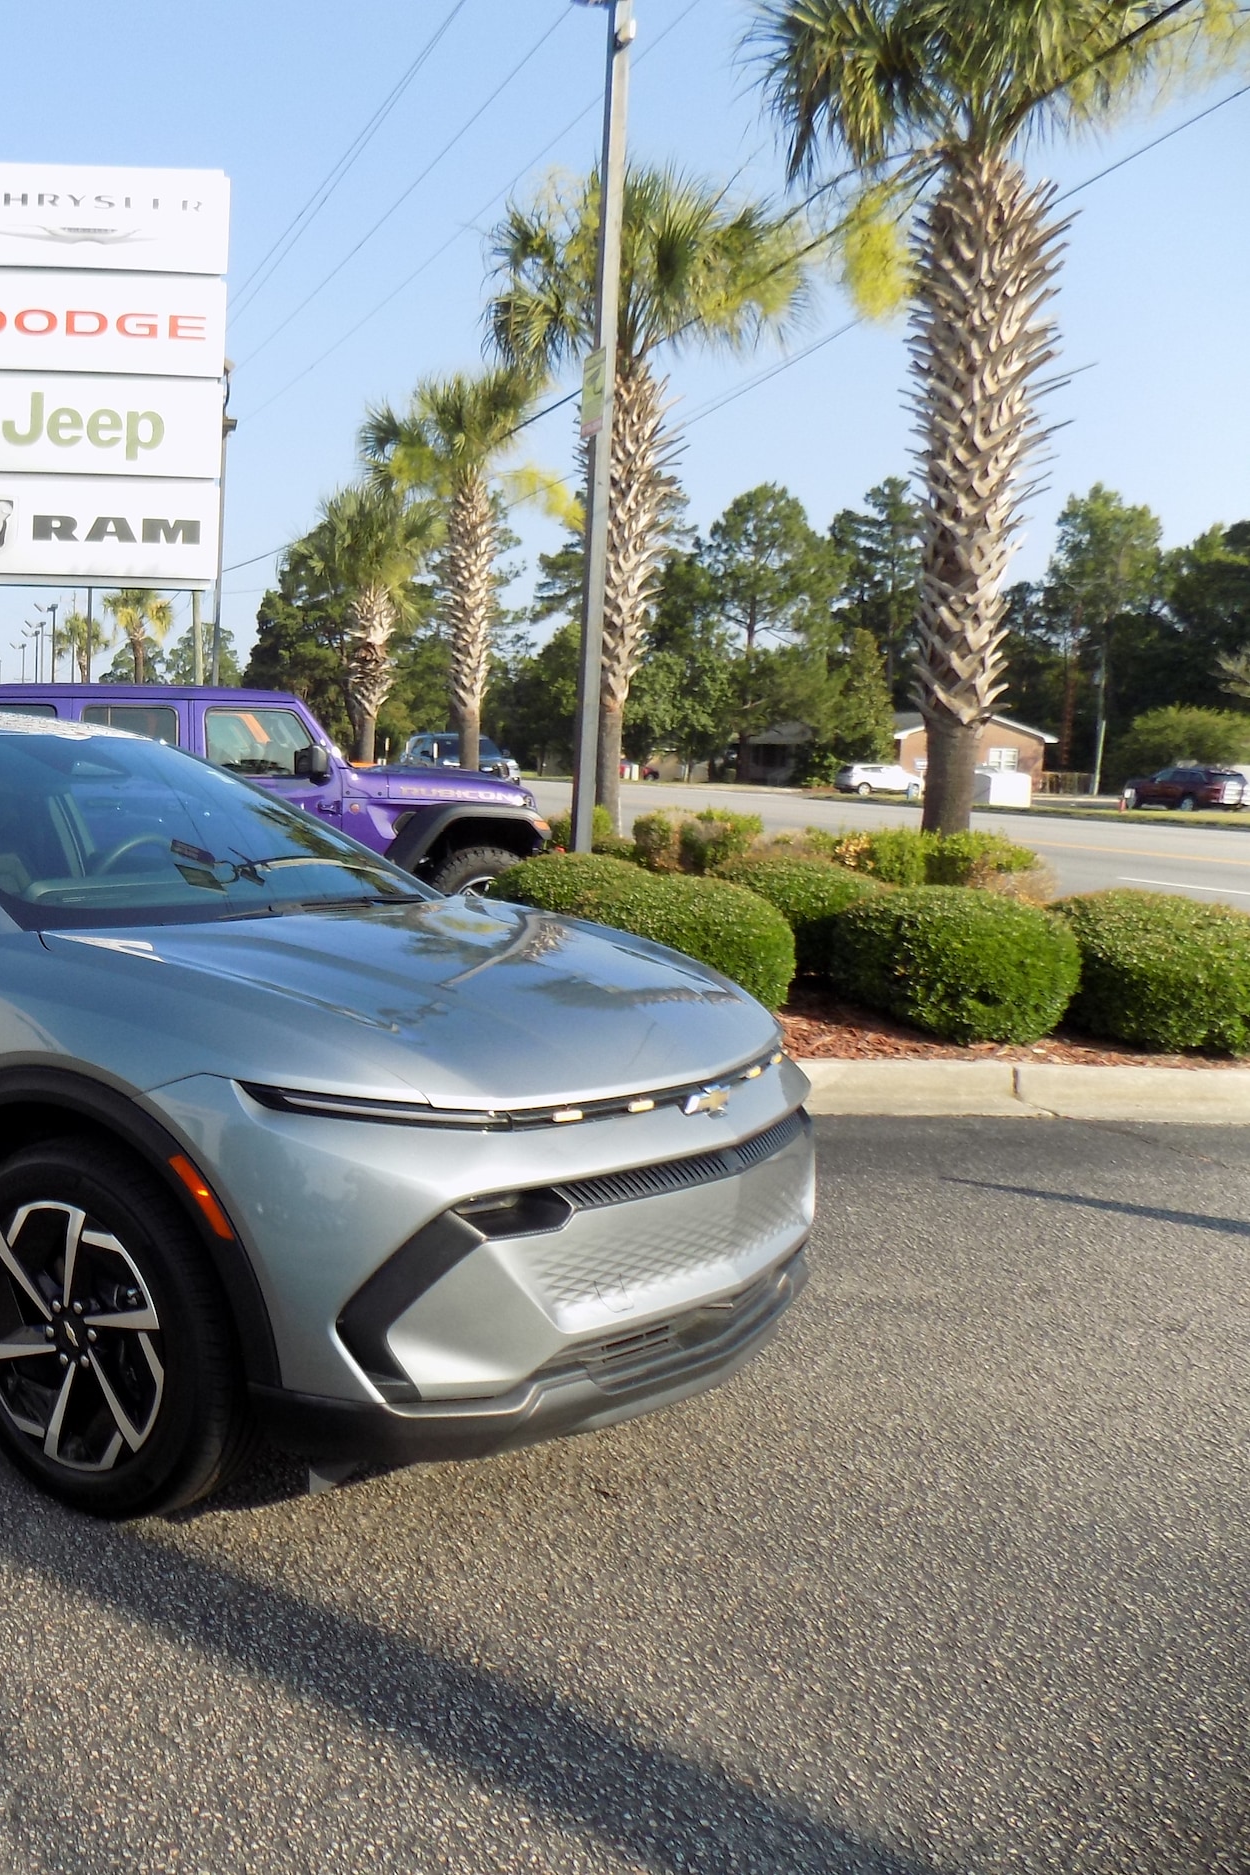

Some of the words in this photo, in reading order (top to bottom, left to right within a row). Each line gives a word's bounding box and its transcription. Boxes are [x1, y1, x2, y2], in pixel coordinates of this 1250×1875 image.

[2, 392, 165, 460] Jeep
[32, 515, 201, 545] RAM
[400, 786, 518, 802] RUBICON
